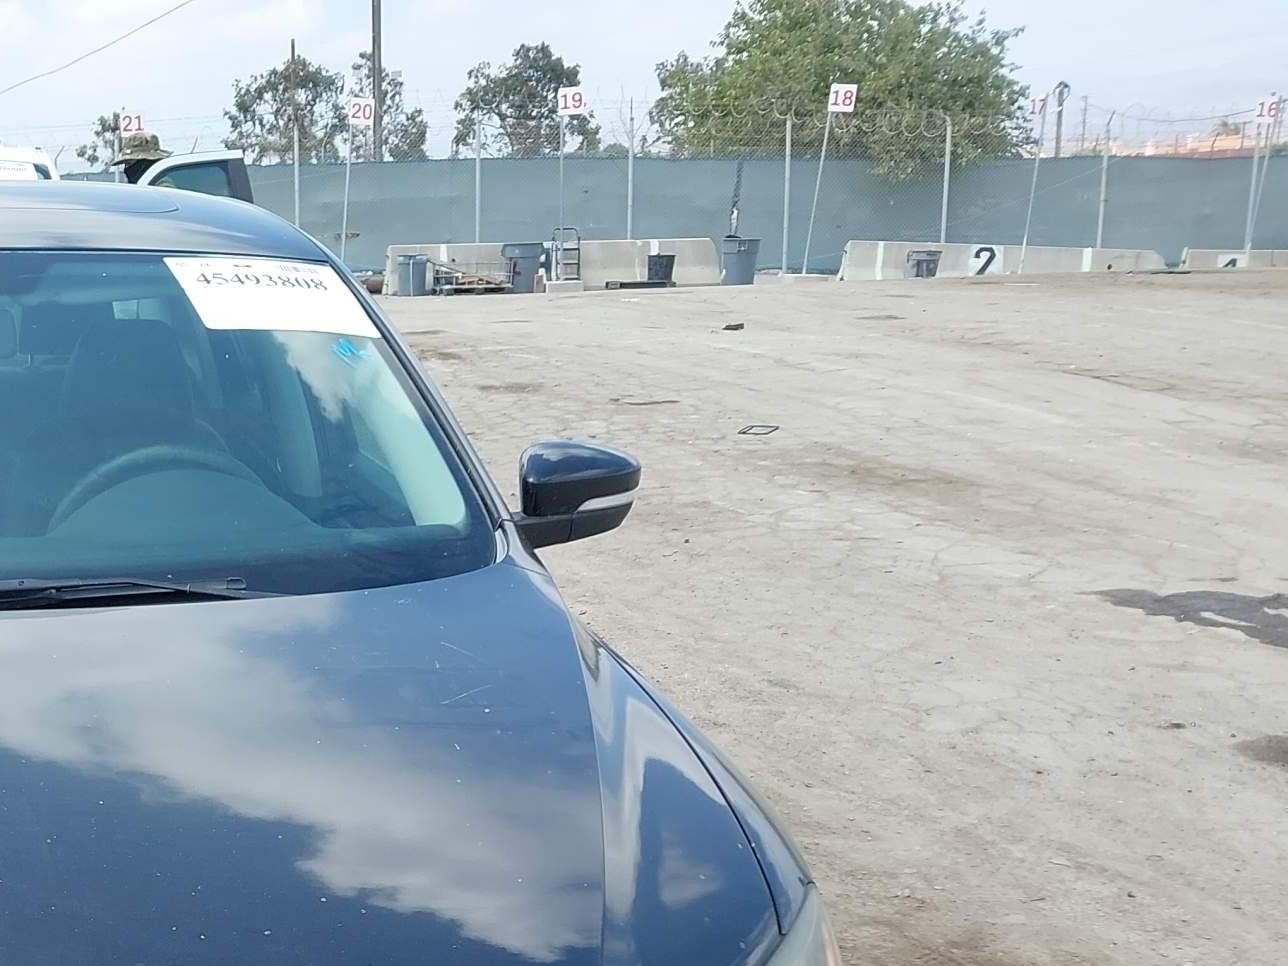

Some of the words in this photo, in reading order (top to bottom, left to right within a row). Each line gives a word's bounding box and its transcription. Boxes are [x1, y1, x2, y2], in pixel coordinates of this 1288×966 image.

[560, 92, 583, 110] 19
[830, 90, 854, 107] 18
[1030, 98, 1047, 115] 17
[352, 103, 373, 120] 20
[122, 115, 144, 132] 21
[195, 272, 329, 292] 45493808
